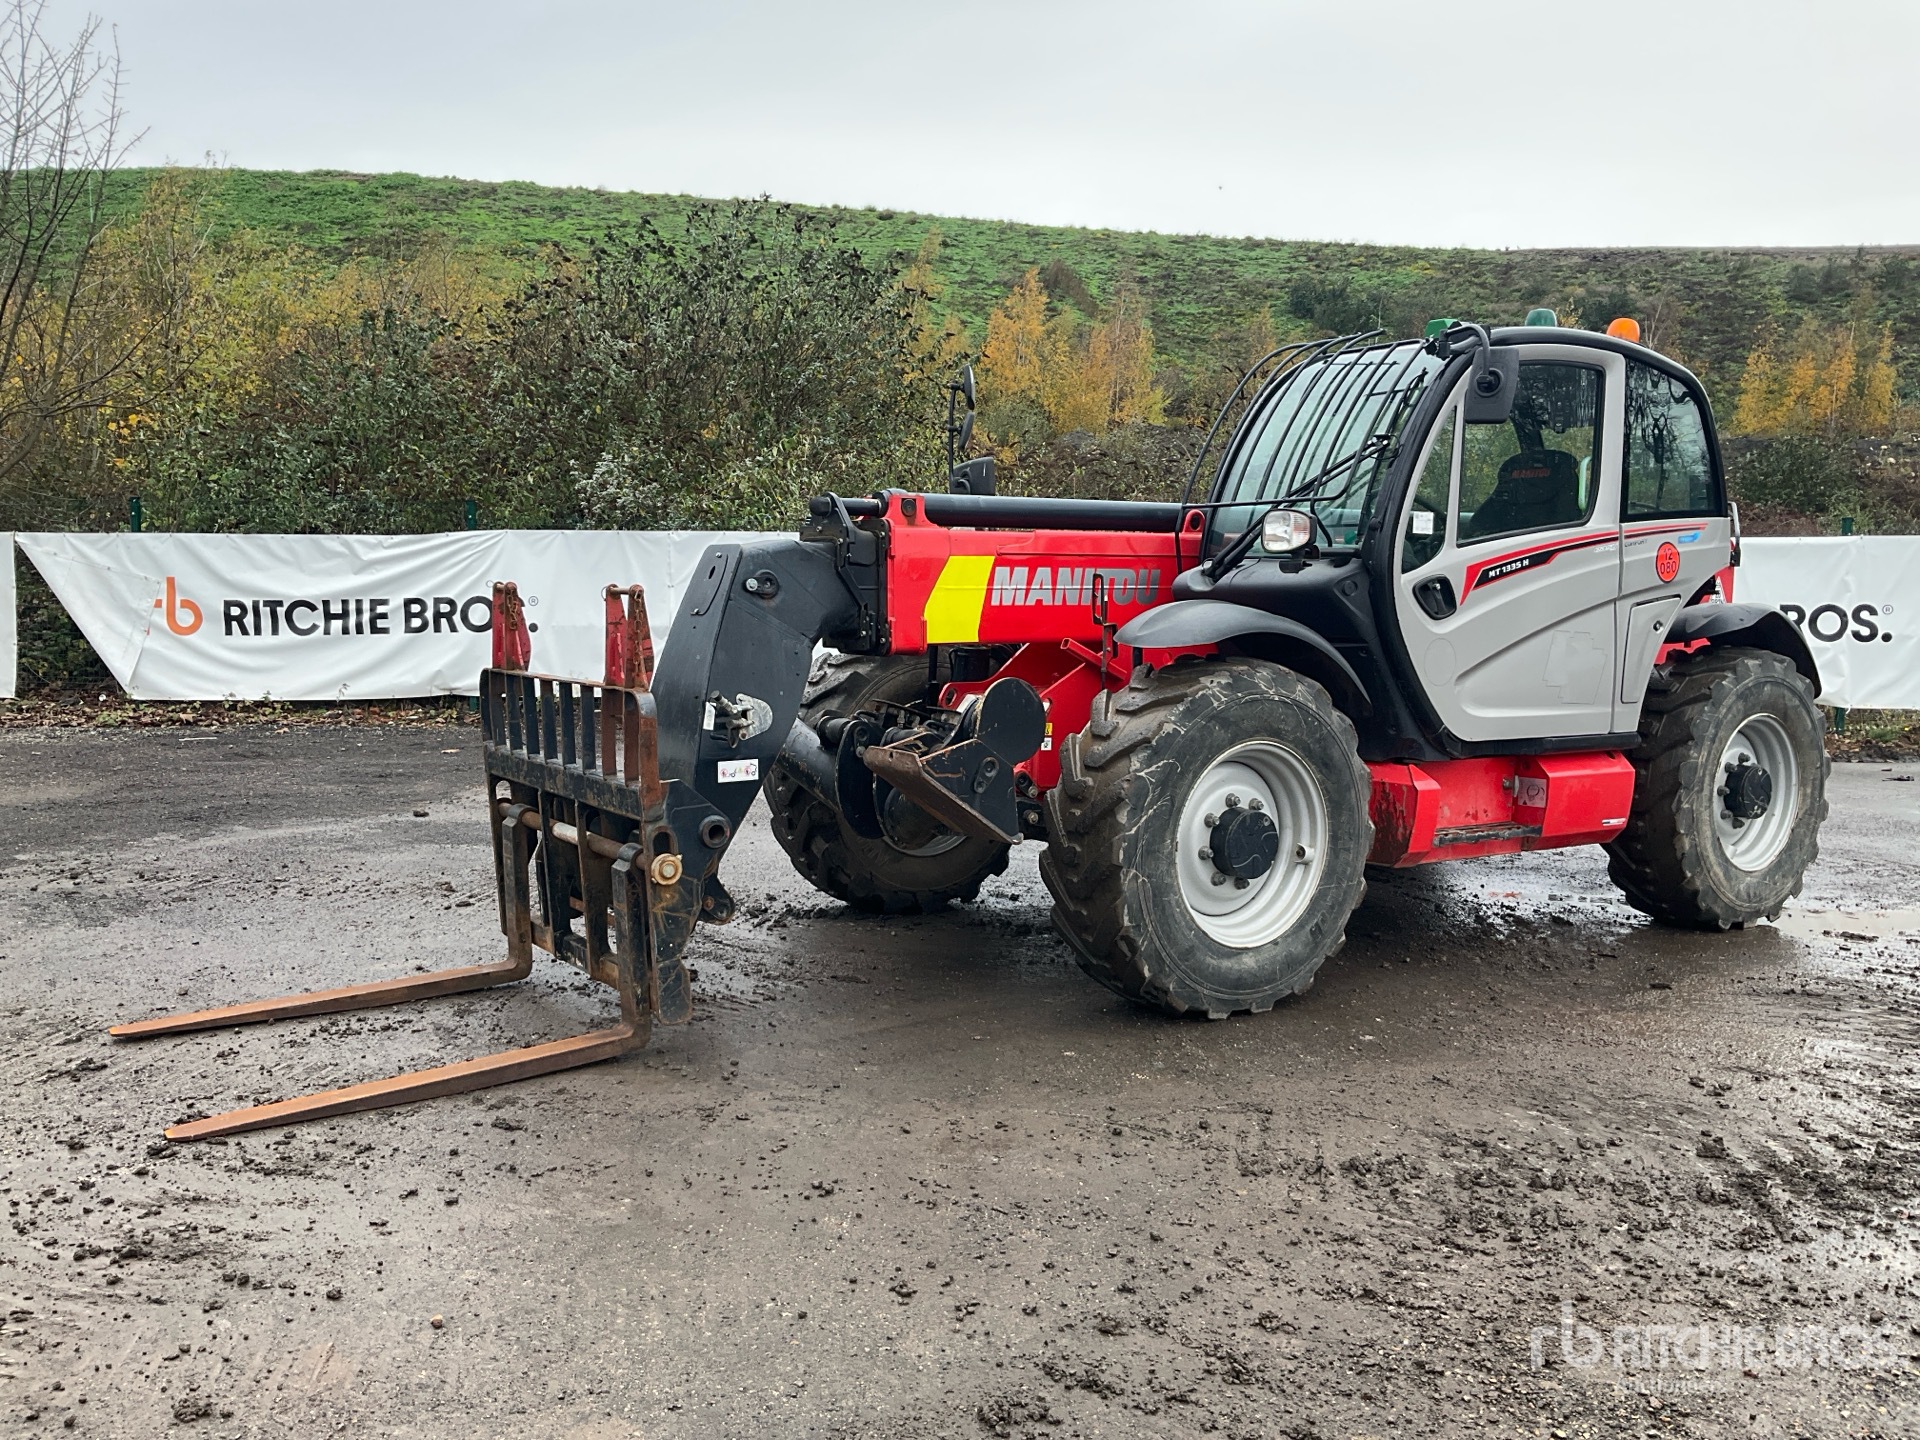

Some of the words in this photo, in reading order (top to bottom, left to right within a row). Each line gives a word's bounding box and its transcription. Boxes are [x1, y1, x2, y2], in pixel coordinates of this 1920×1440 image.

[990, 566, 1161, 606] MANITOU
[1488, 568, 1501, 578] MT
[1501, 561, 1522, 573] 1335
[1522, 558, 1530, 567] H
[1659, 561, 1677, 575] 080
[223, 598, 391, 636] RITCHIE
[403, 595, 539, 634] BRO.
[1779, 603, 1893, 643] ROS.
